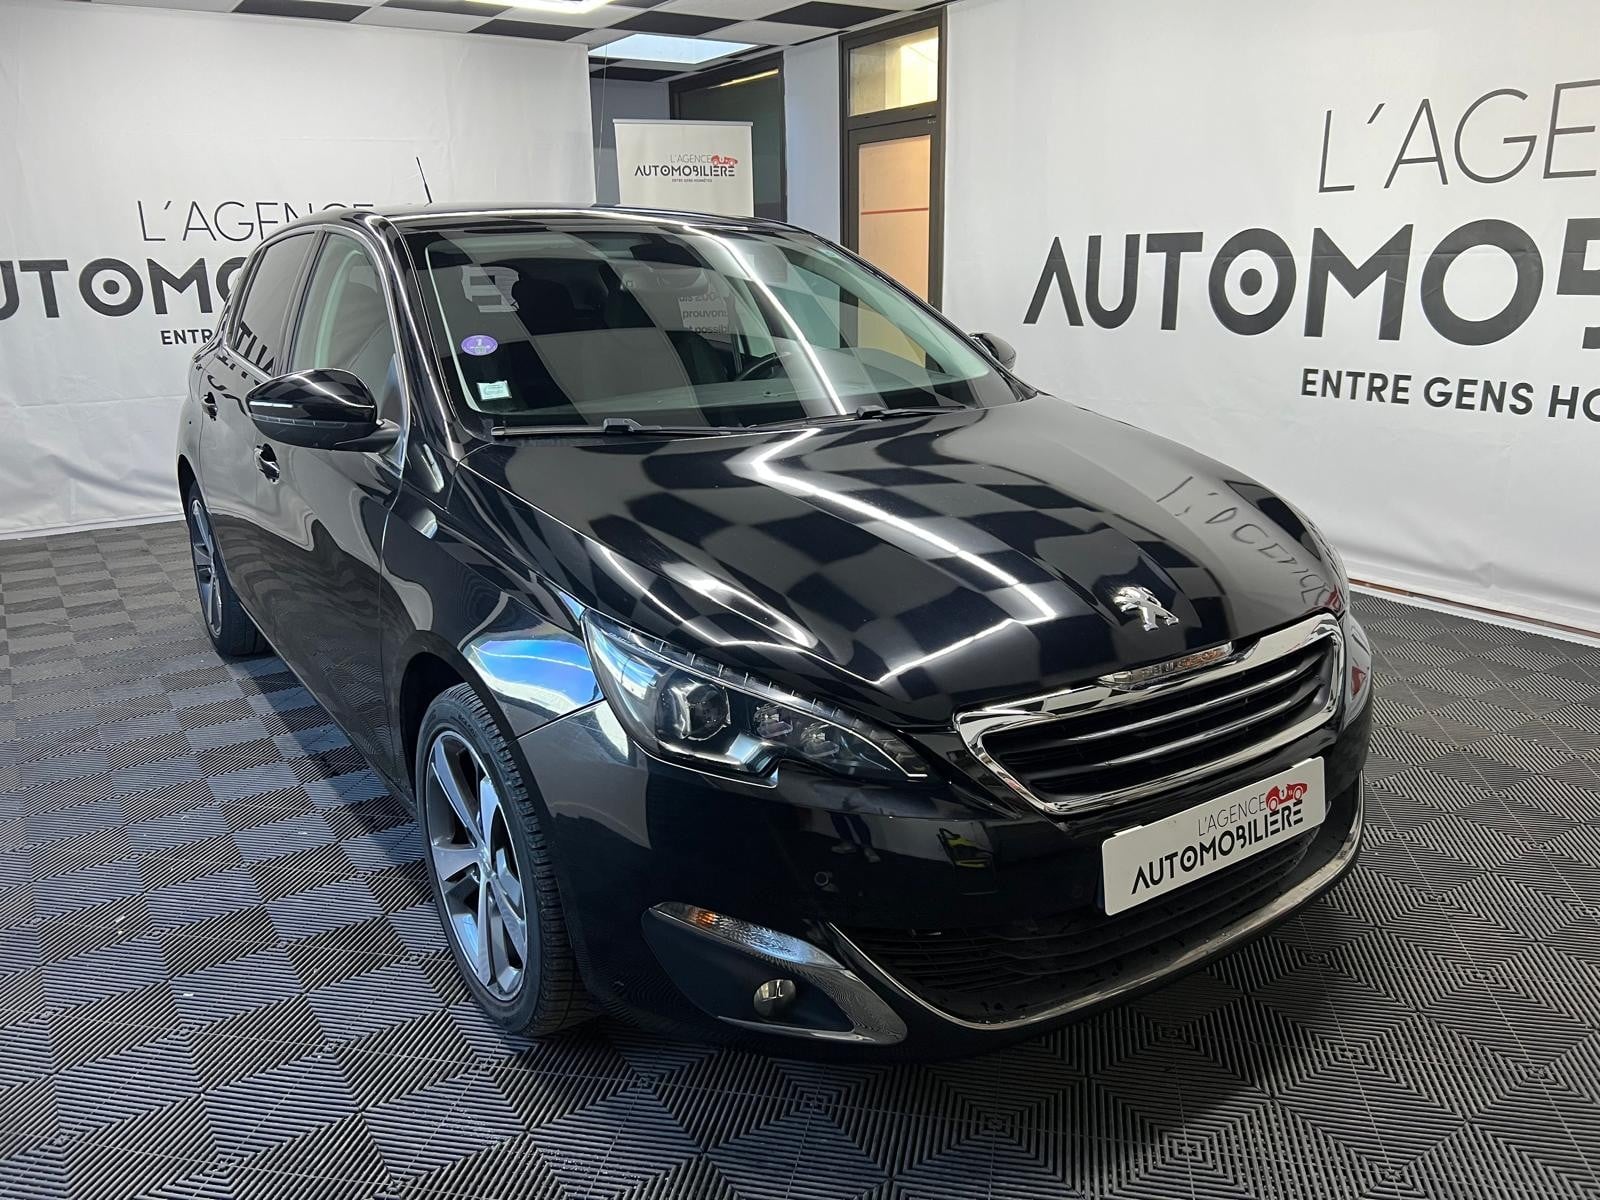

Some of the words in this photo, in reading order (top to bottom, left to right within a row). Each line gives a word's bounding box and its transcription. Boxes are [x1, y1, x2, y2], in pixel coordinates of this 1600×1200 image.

[136, 200, 374, 242] L'AGE
[1300, 368, 1413, 405] ENTRE
[1423, 376, 1534, 416] GENS
[1198, 793, 1267, 837] L'AGENCE
